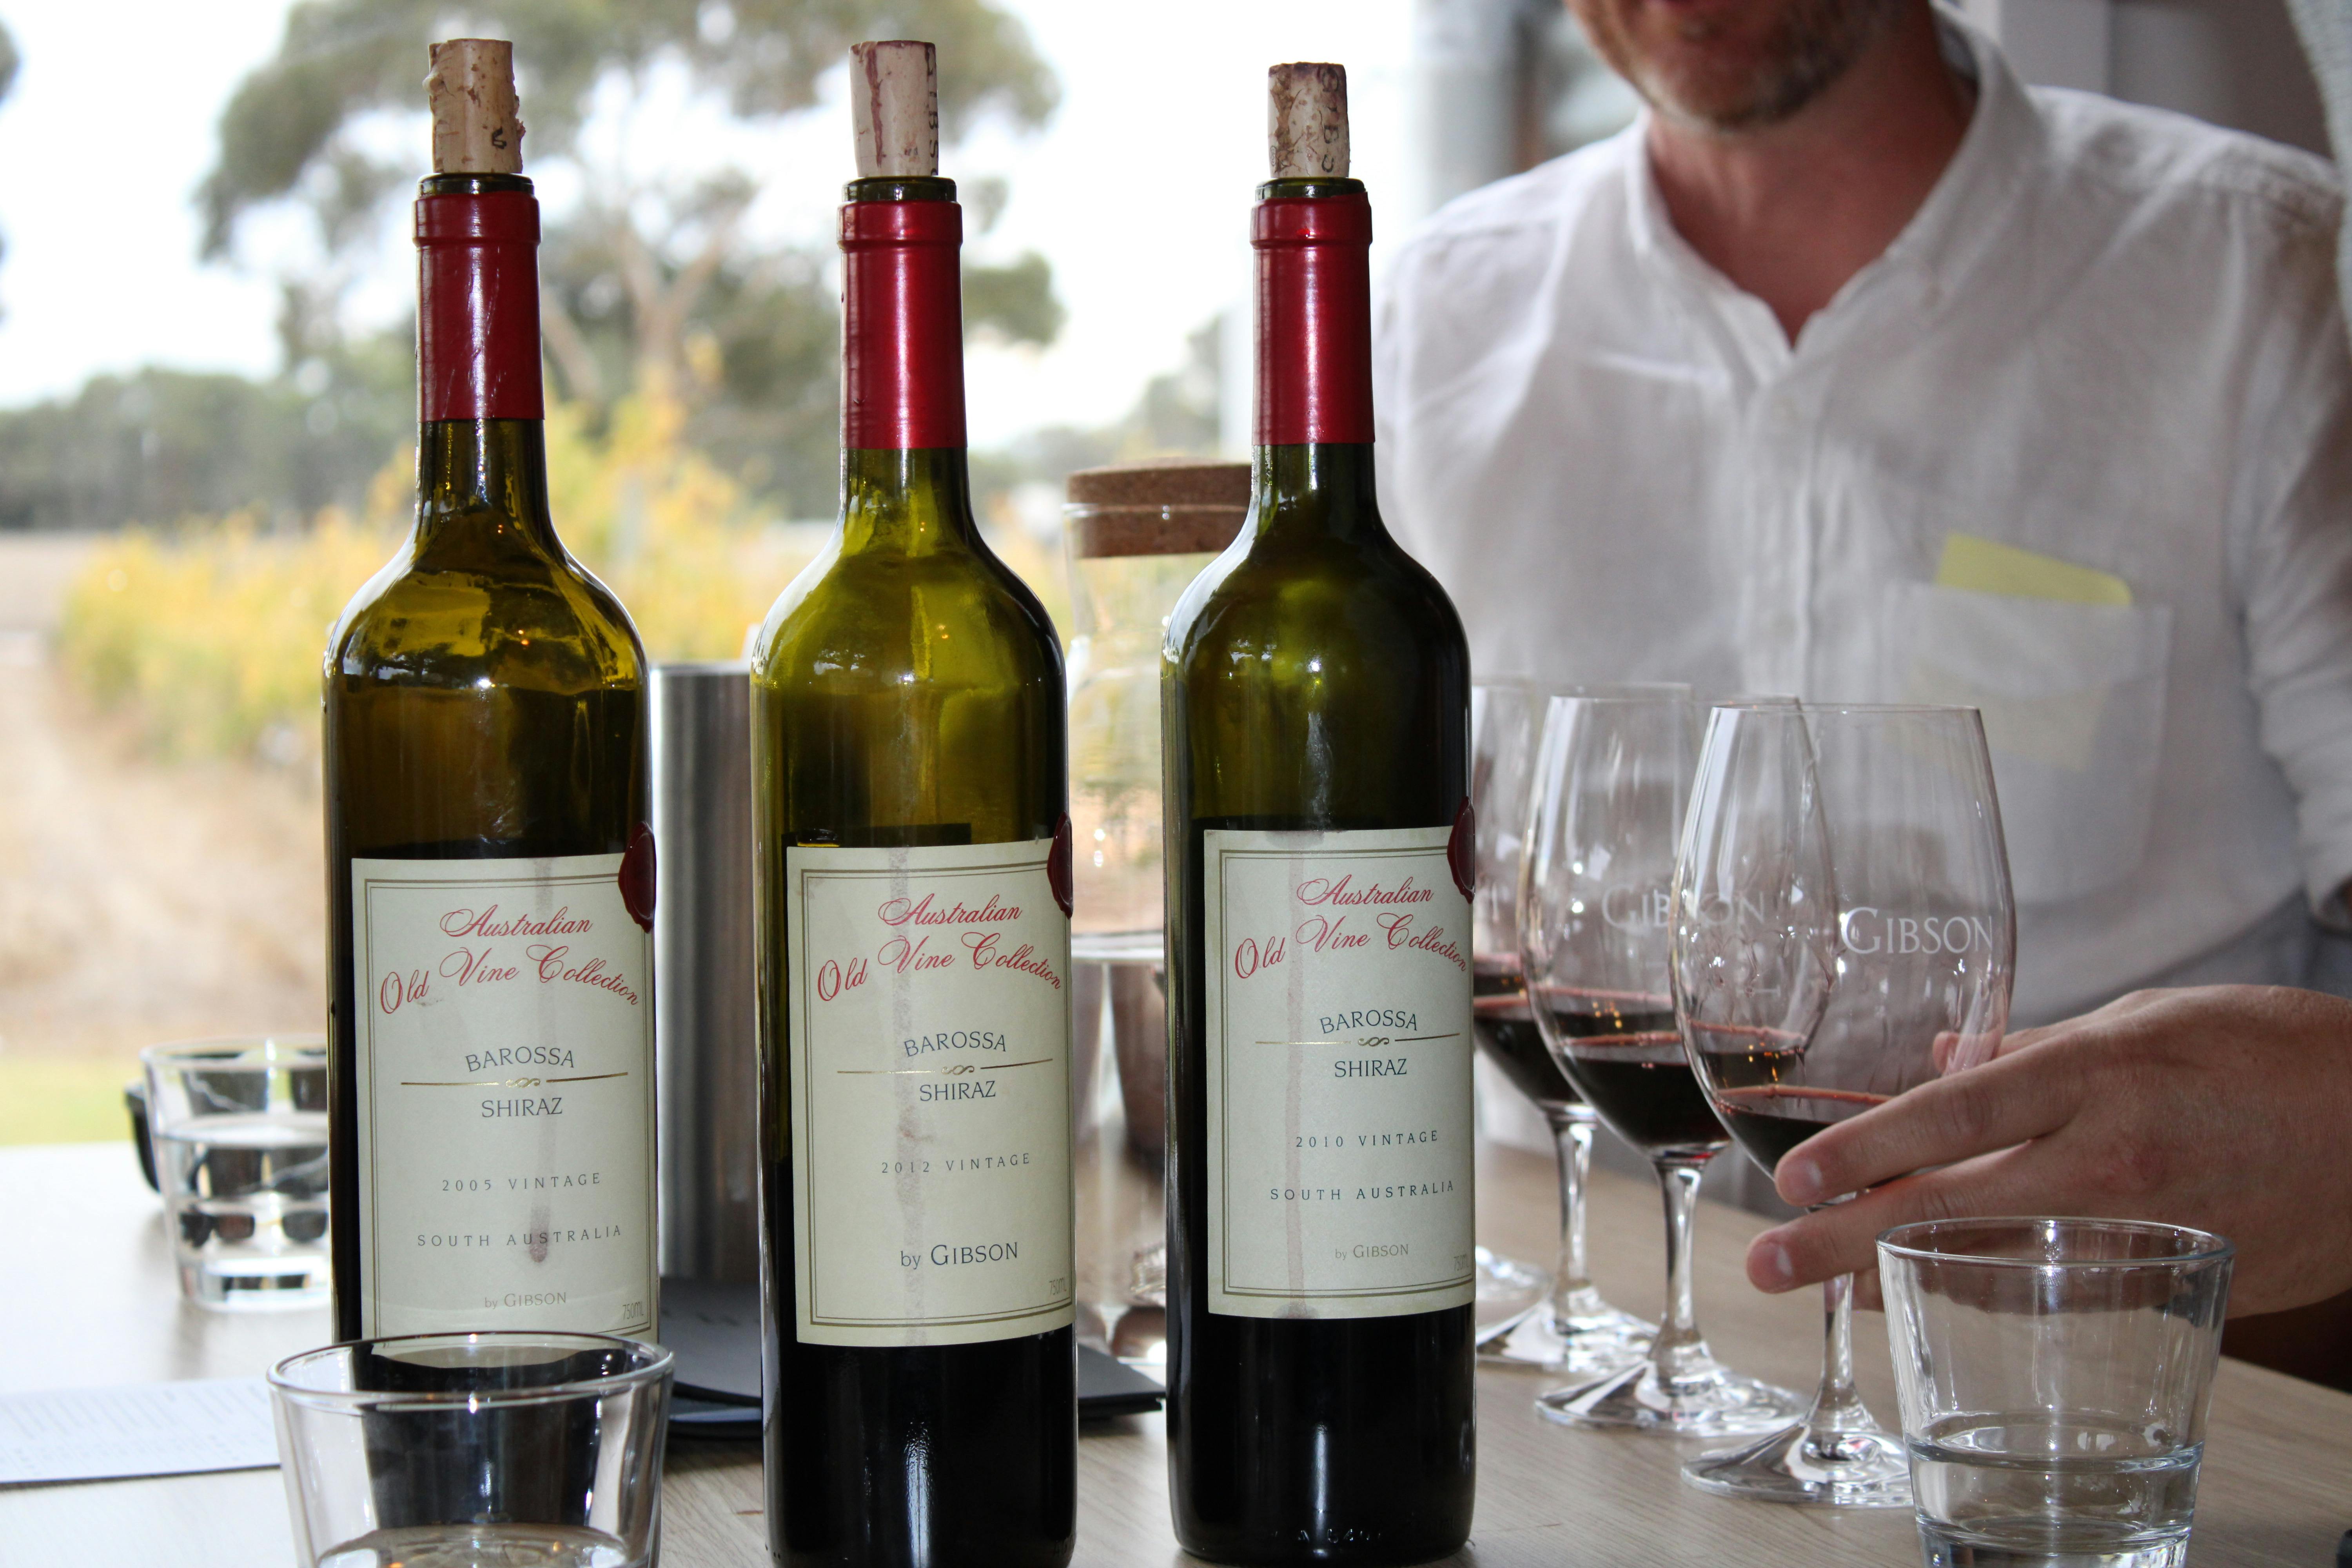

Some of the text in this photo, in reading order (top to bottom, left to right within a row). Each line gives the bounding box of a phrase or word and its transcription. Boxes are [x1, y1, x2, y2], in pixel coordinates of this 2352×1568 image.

[1297, 874, 1434, 906] Australian
[440, 904, 592, 937] Australian
[878, 893, 1022, 926] Australian
[1841, 906, 1993, 954] GIBSON
[1235, 912, 1466, 979] Old Vine Collection
[381, 944, 639, 1014] Old Vine Collection
[818, 932, 1061, 1002] Old Vine Collection
[1320, 1010, 1418, 1034] BAROSSA
[904, 1031, 1005, 1056] BAROSSA
[465, 1046, 574, 1072] BAROSSA
[1335, 1059, 1406, 1077] SHIRAZ
[920, 1081, 995, 1101] SHIRAZ
[482, 1098, 562, 1118] SHIRAZ
[1296, 1131, 1437, 1147] 2010 VINTAGE
[882, 1153, 1029, 1173] 2012 VINTAGE
[443, 1173, 599, 1191] 2005 VINTAGE
[1271, 1181, 1452, 1200] SOUTH AUSTRALIA
[418, 1225, 620, 1247] SOUTH AUSTRALIA
[901, 1242, 1017, 1270] by GIBSON
[1335, 1244, 1408, 1260] by GIBSON
[485, 1292, 566, 1309] by GIBSON
